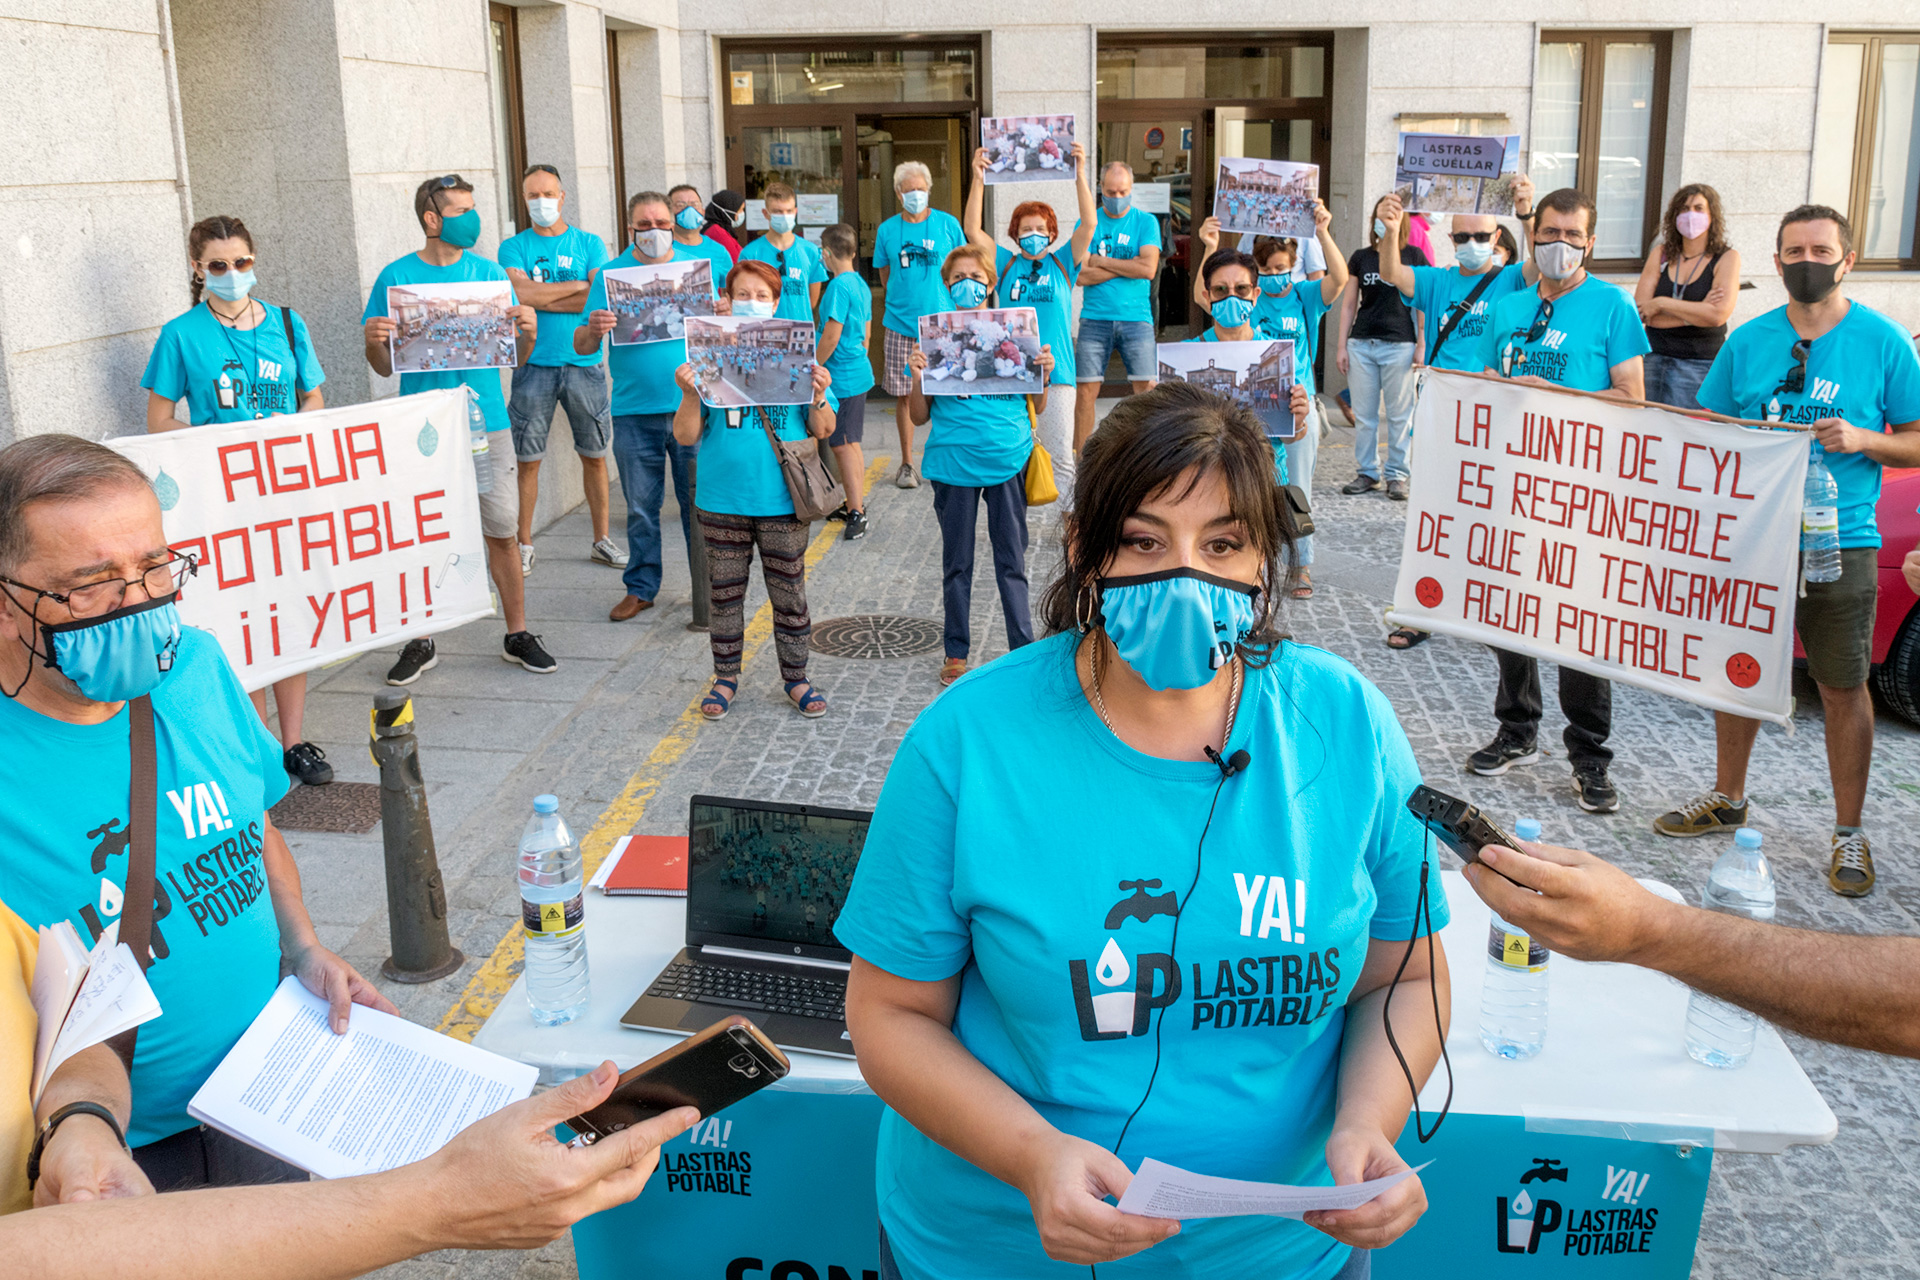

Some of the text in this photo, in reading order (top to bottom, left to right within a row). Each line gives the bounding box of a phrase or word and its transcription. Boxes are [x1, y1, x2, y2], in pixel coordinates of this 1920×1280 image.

[1410, 155, 1494, 171] DE CUÉLLAR
[1422, 144, 1482, 155] LASTRAS
[557, 254, 573, 270] YA!
[1281, 316, 1298, 332] YA!
[1541, 328, 1568, 350] YA!
[258, 358, 282, 382] YA!
[1522, 364, 1567, 382] POTABLE
[1524, 351, 1569, 368] LASTRAS
[212, 378, 244, 409] LP
[246, 383, 288, 396] LASTRAS
[1810, 376, 1840, 404] YA!
[217, 422, 387, 503] AGUA
[1455, 400, 1756, 501] LA JUNTA DE CYL
[1457, 459, 1738, 564] ES RESPONSABLE
[1416, 510, 1780, 635] DE QUE NO TENGAMOS
[1463, 578, 1704, 683] AGUA POTABLE
[165, 777, 234, 840] YA!
[165, 820, 264, 904] LASTRAS
[186, 860, 266, 938] POTABLE
[1232, 872, 1306, 945] YA!
[1192, 947, 1341, 1001] LASTRAS
[1068, 952, 1183, 1042] LP
[1190, 987, 1339, 1032] POTABLE
[689, 1116, 733, 1149] YA!
[663, 1151, 752, 1174] LASTRAS
[666, 1172, 752, 1197] POTABLE
[1601, 1164, 1651, 1206] YA!
[1496, 1196, 1563, 1255] LP
[1566, 1208, 1660, 1233] LASTRAS
[1563, 1231, 1654, 1257] POTABLE
